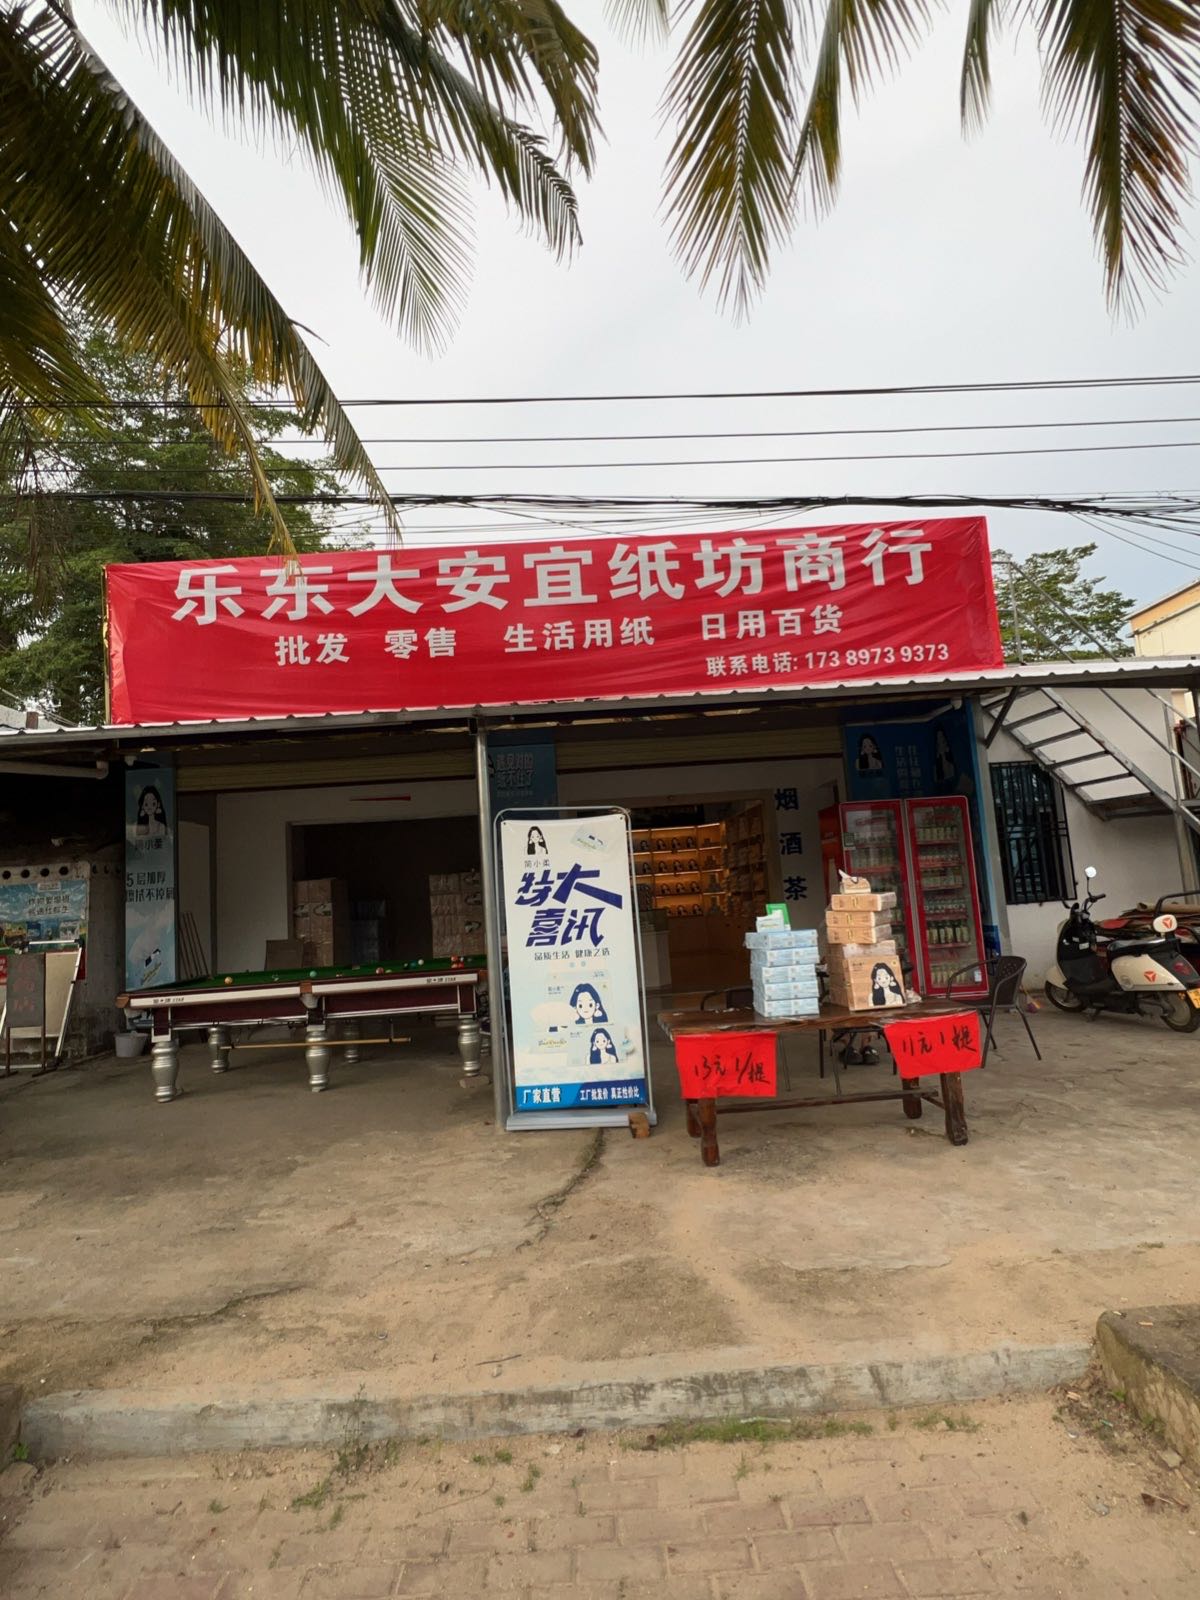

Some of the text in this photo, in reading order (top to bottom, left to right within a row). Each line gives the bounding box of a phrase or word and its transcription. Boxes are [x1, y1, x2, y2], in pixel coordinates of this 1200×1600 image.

[172, 528, 933, 626] 乐东大安宜纸坊商行
[275, 604, 843, 666] 批发 零售 生活用纸 日用百货
[706, 644, 950, 677] 联系电话: 173 8973 9373
[515, 863, 623, 910] 特大
[525, 907, 606, 948] 喜讯
[523, 1087, 561, 1104] 厂家直营
